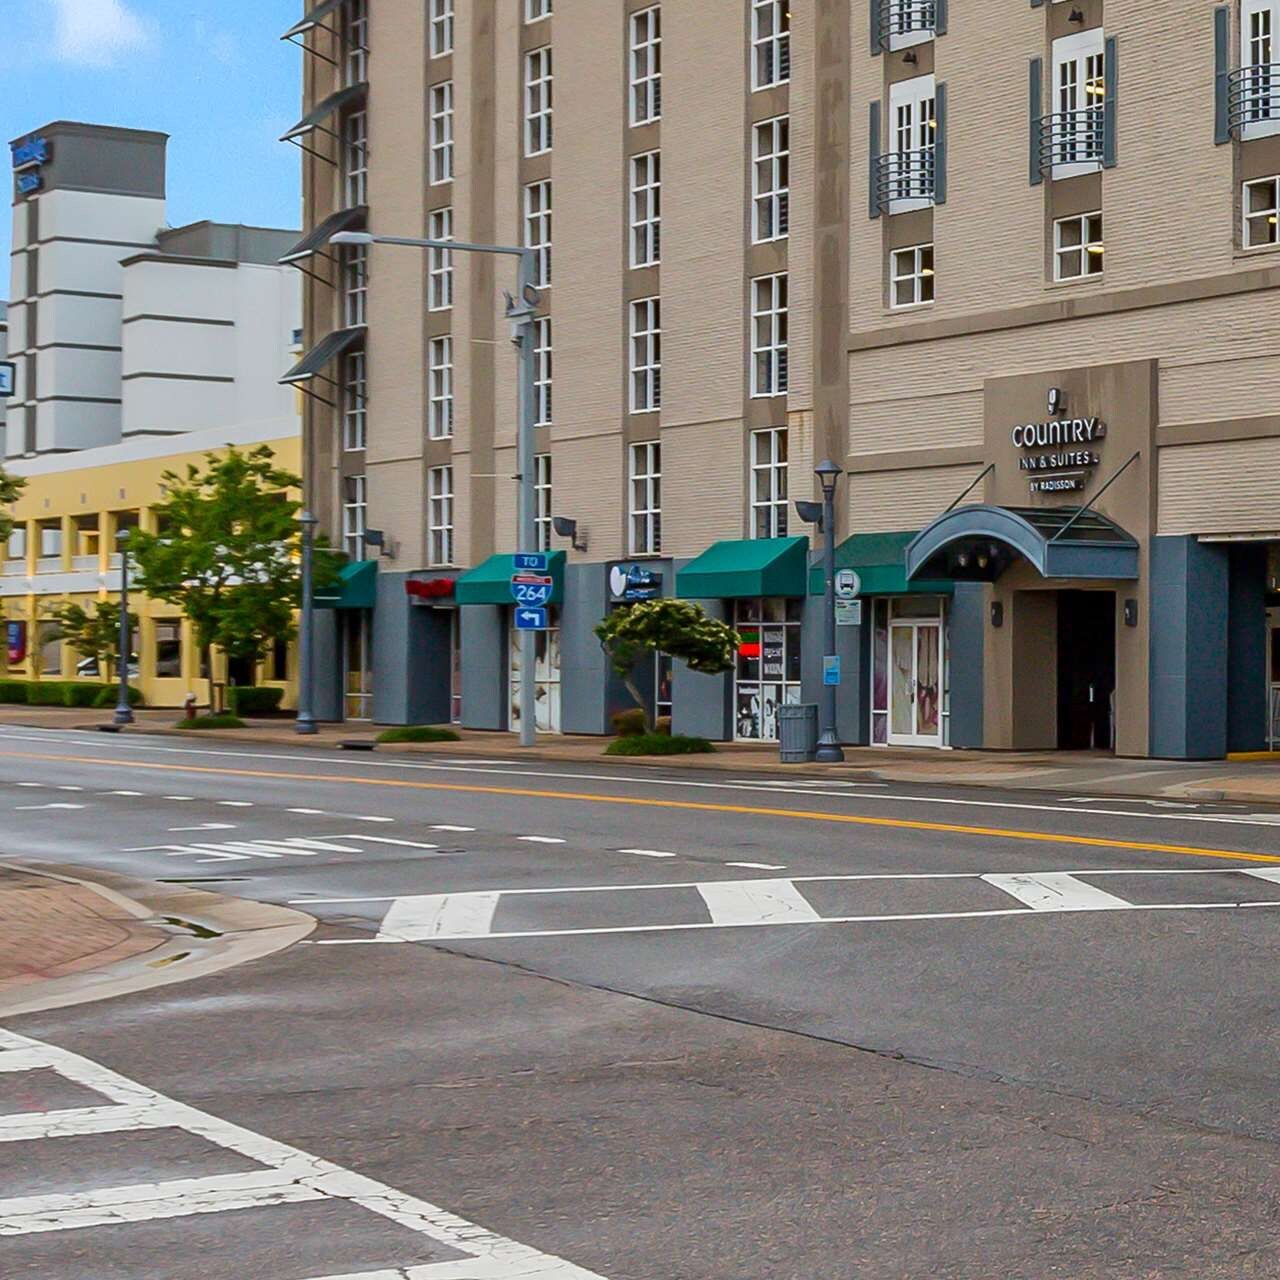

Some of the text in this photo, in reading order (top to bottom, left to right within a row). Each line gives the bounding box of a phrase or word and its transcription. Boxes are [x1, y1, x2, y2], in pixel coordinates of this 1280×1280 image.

[1012, 418, 1095, 447] COUNTRY
[1018, 451, 1089, 470] INN & SUITES
[1030, 480, 1076, 492] BY RADISSON
[523, 556, 538, 567] TO
[517, 585, 546, 601] 264
